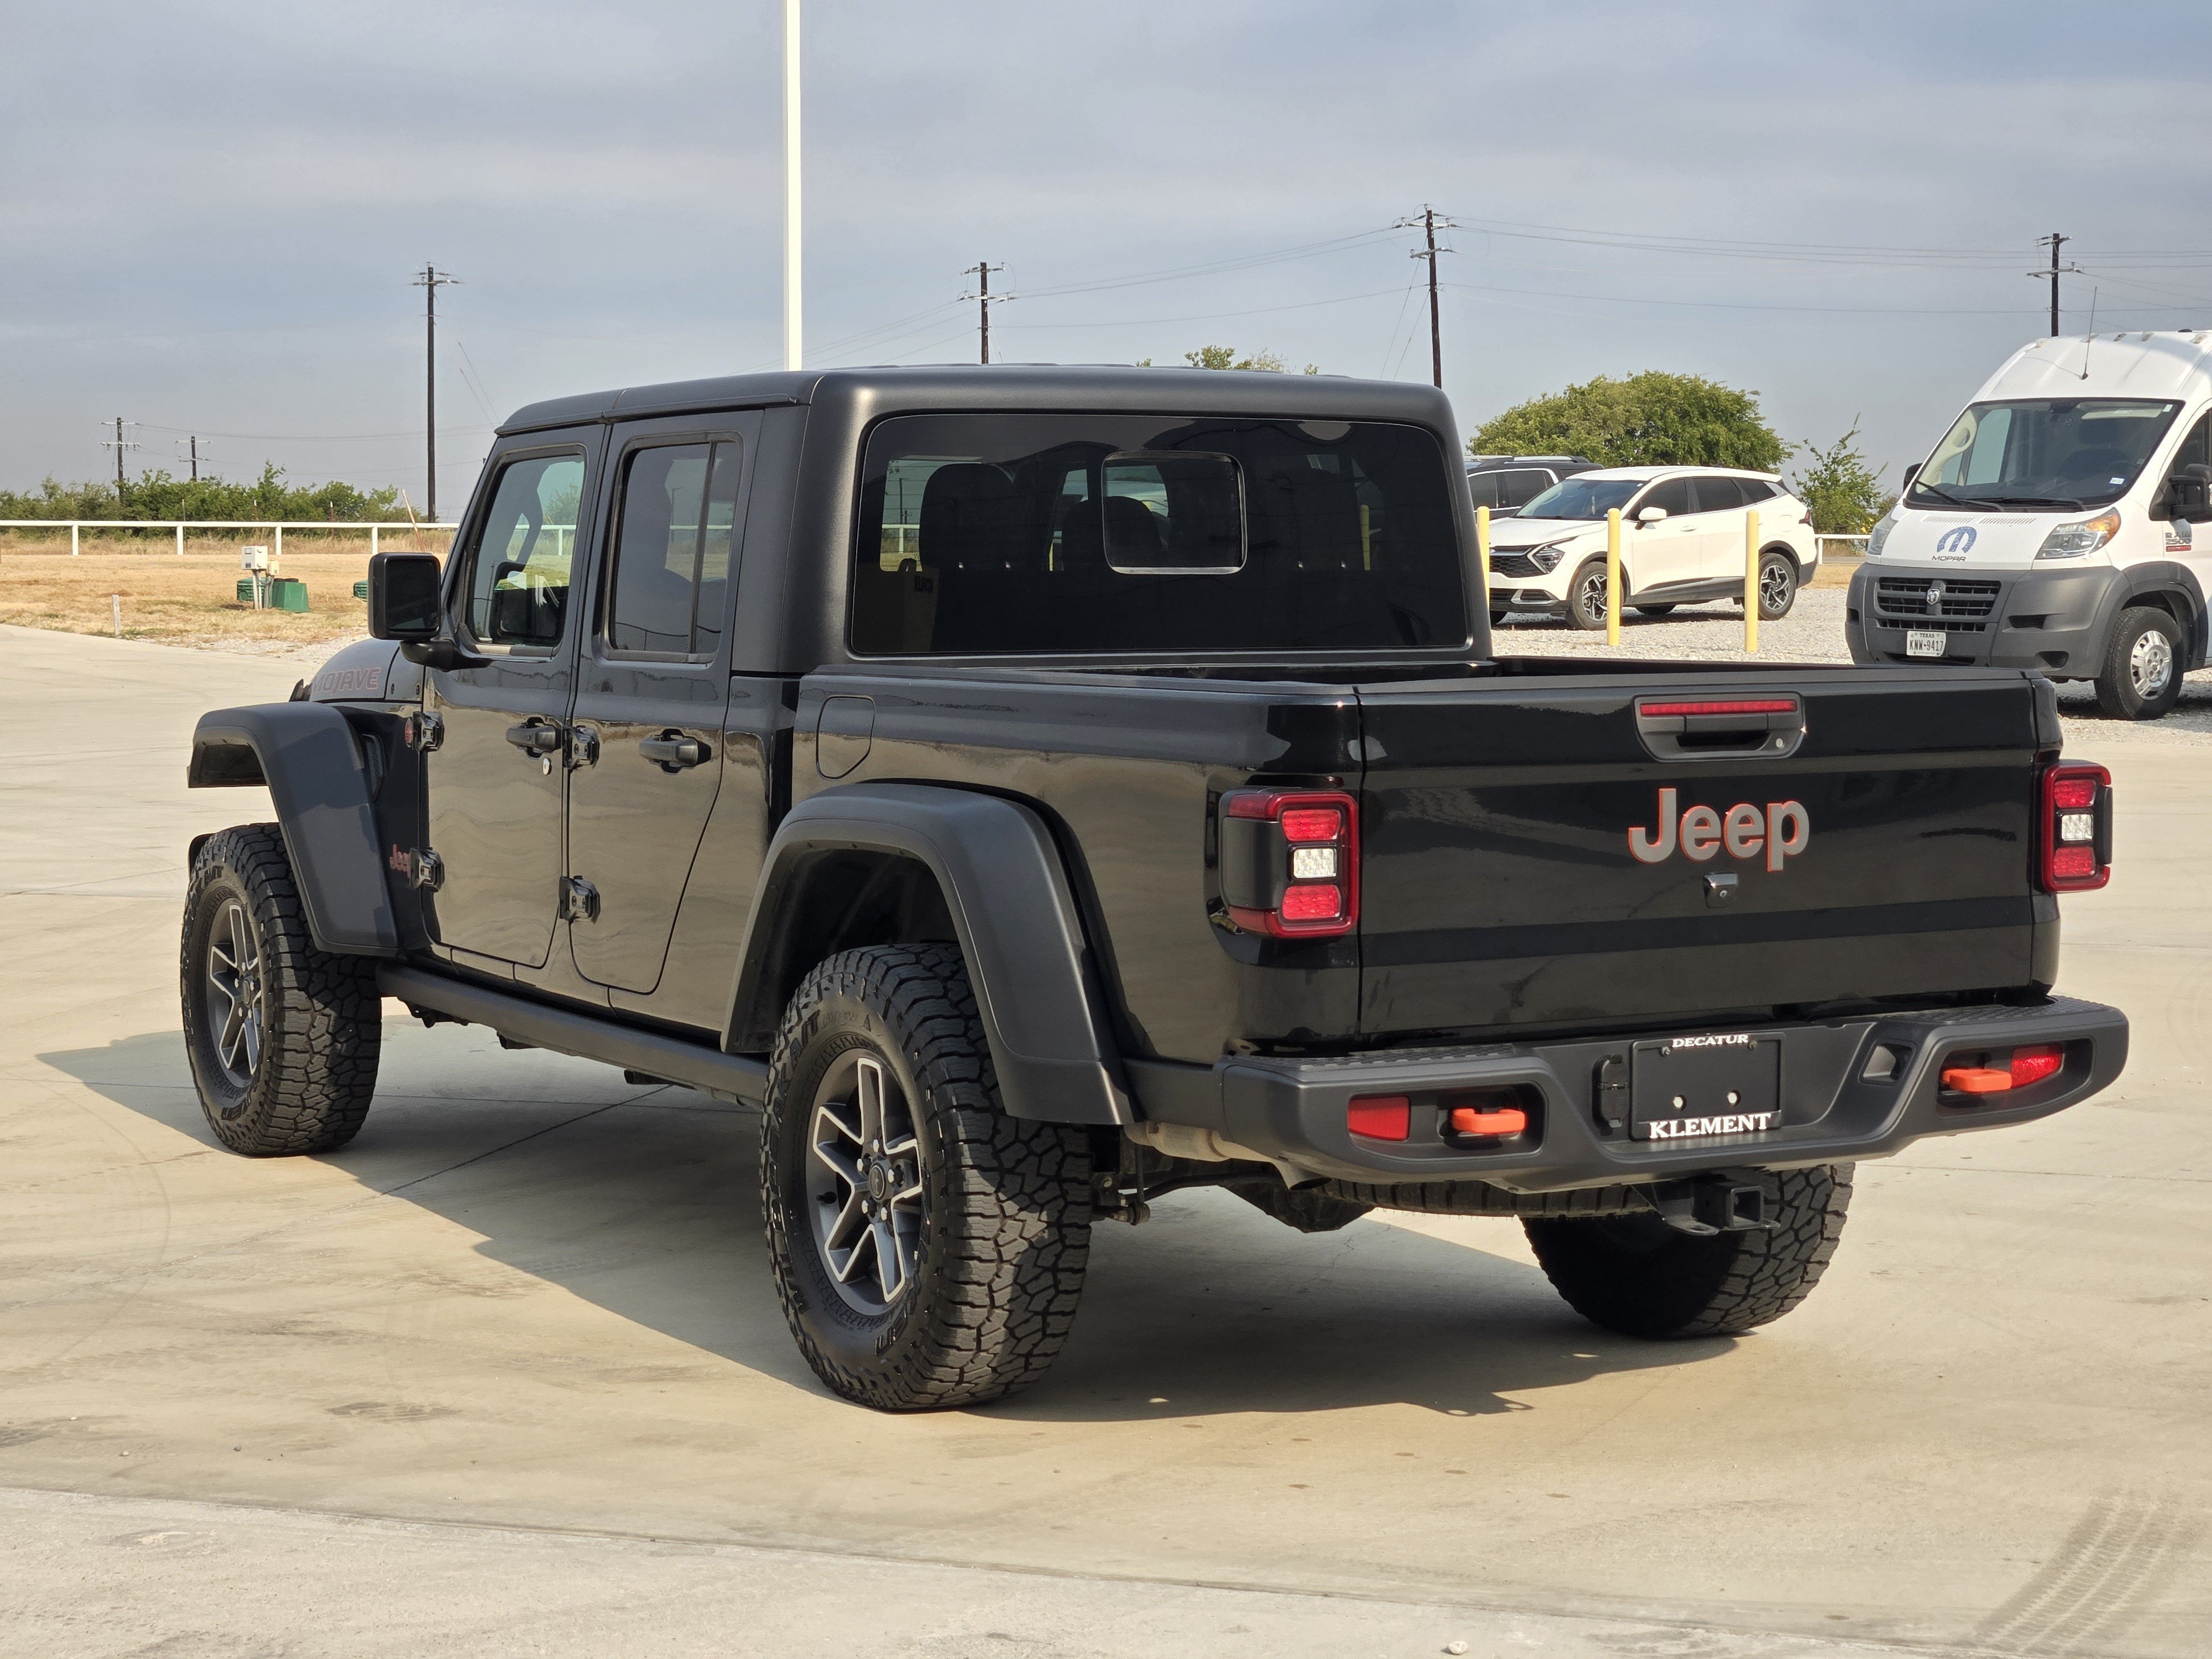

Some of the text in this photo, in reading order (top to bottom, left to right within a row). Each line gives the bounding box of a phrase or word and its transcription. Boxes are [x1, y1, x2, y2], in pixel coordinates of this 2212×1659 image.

[1627, 787, 1810, 872] Jeep
[1672, 1034, 1749, 1048] DECATUR
[1649, 1113, 1772, 1139] KLEMENT
